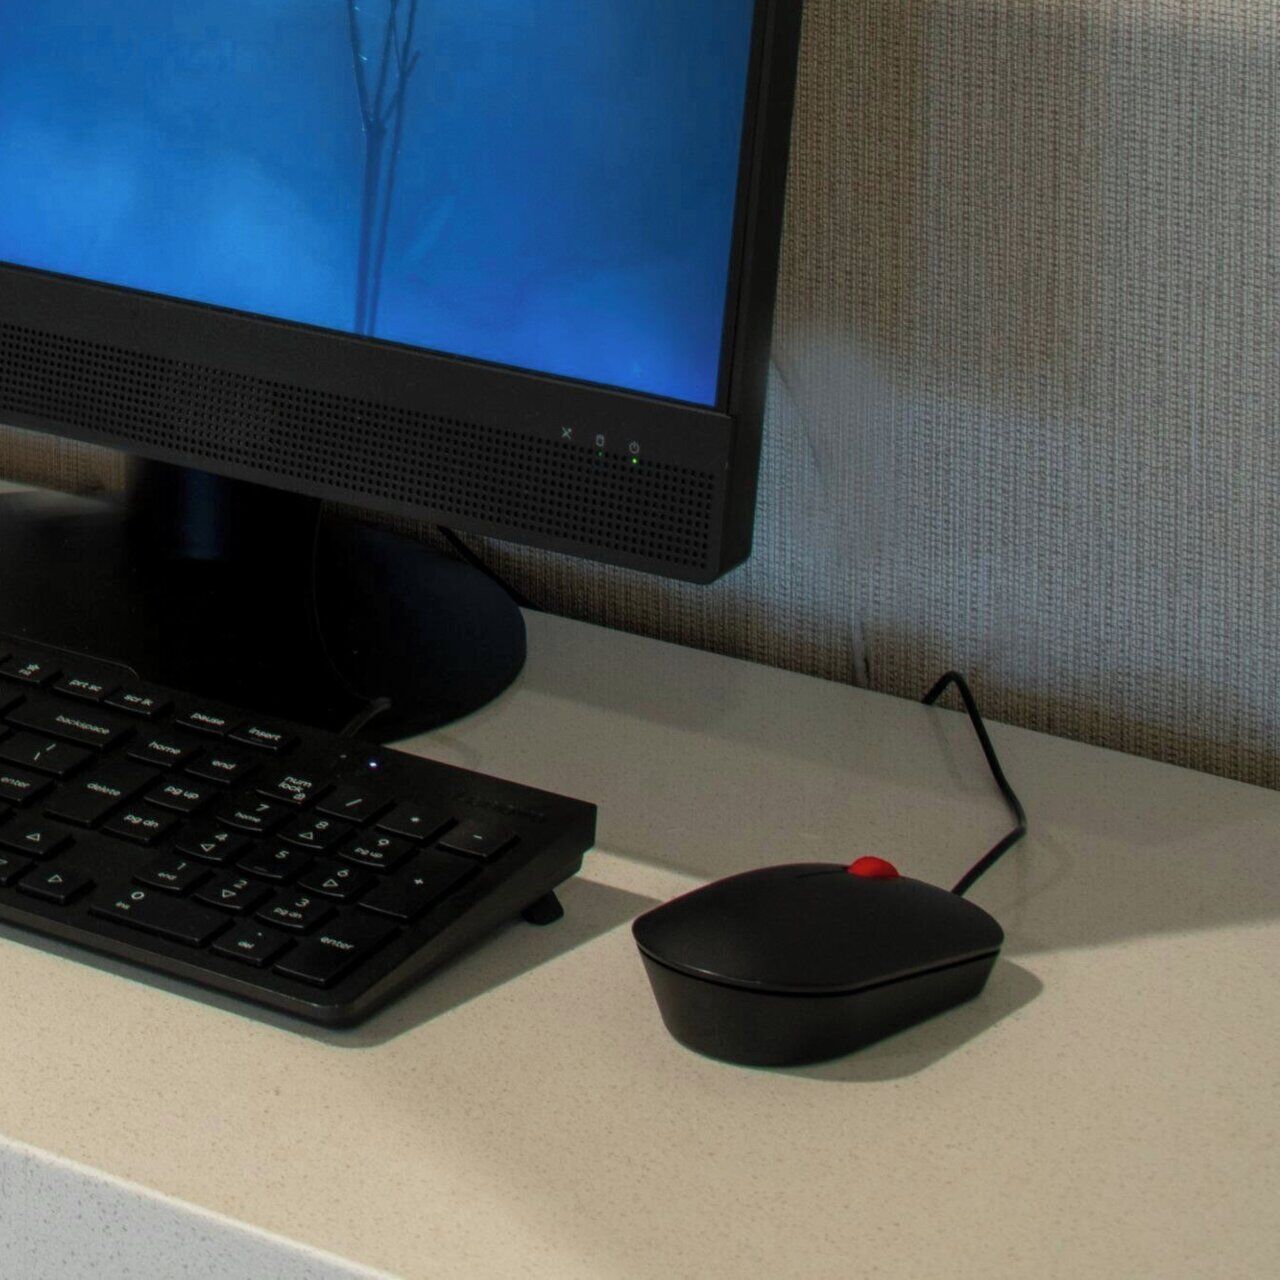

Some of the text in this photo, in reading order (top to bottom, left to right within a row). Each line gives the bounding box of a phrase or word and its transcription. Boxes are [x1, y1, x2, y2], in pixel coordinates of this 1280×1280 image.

[56, 716, 109, 734] backspace
[191, 713, 224, 725] pause
[249, 728, 281, 740] insert
[149, 741, 180, 754] home
[212, 761, 235, 769] end
[1, 777, 30, 787] enter
[87, 783, 120, 796] delete
[165, 786, 199, 799] pg up
[124, 815, 142, 823] pg
[235, 811, 261, 823] home
[316, 821, 328, 829] 8
[296, 899, 309, 907] 3
[321, 937, 353, 949] enter
